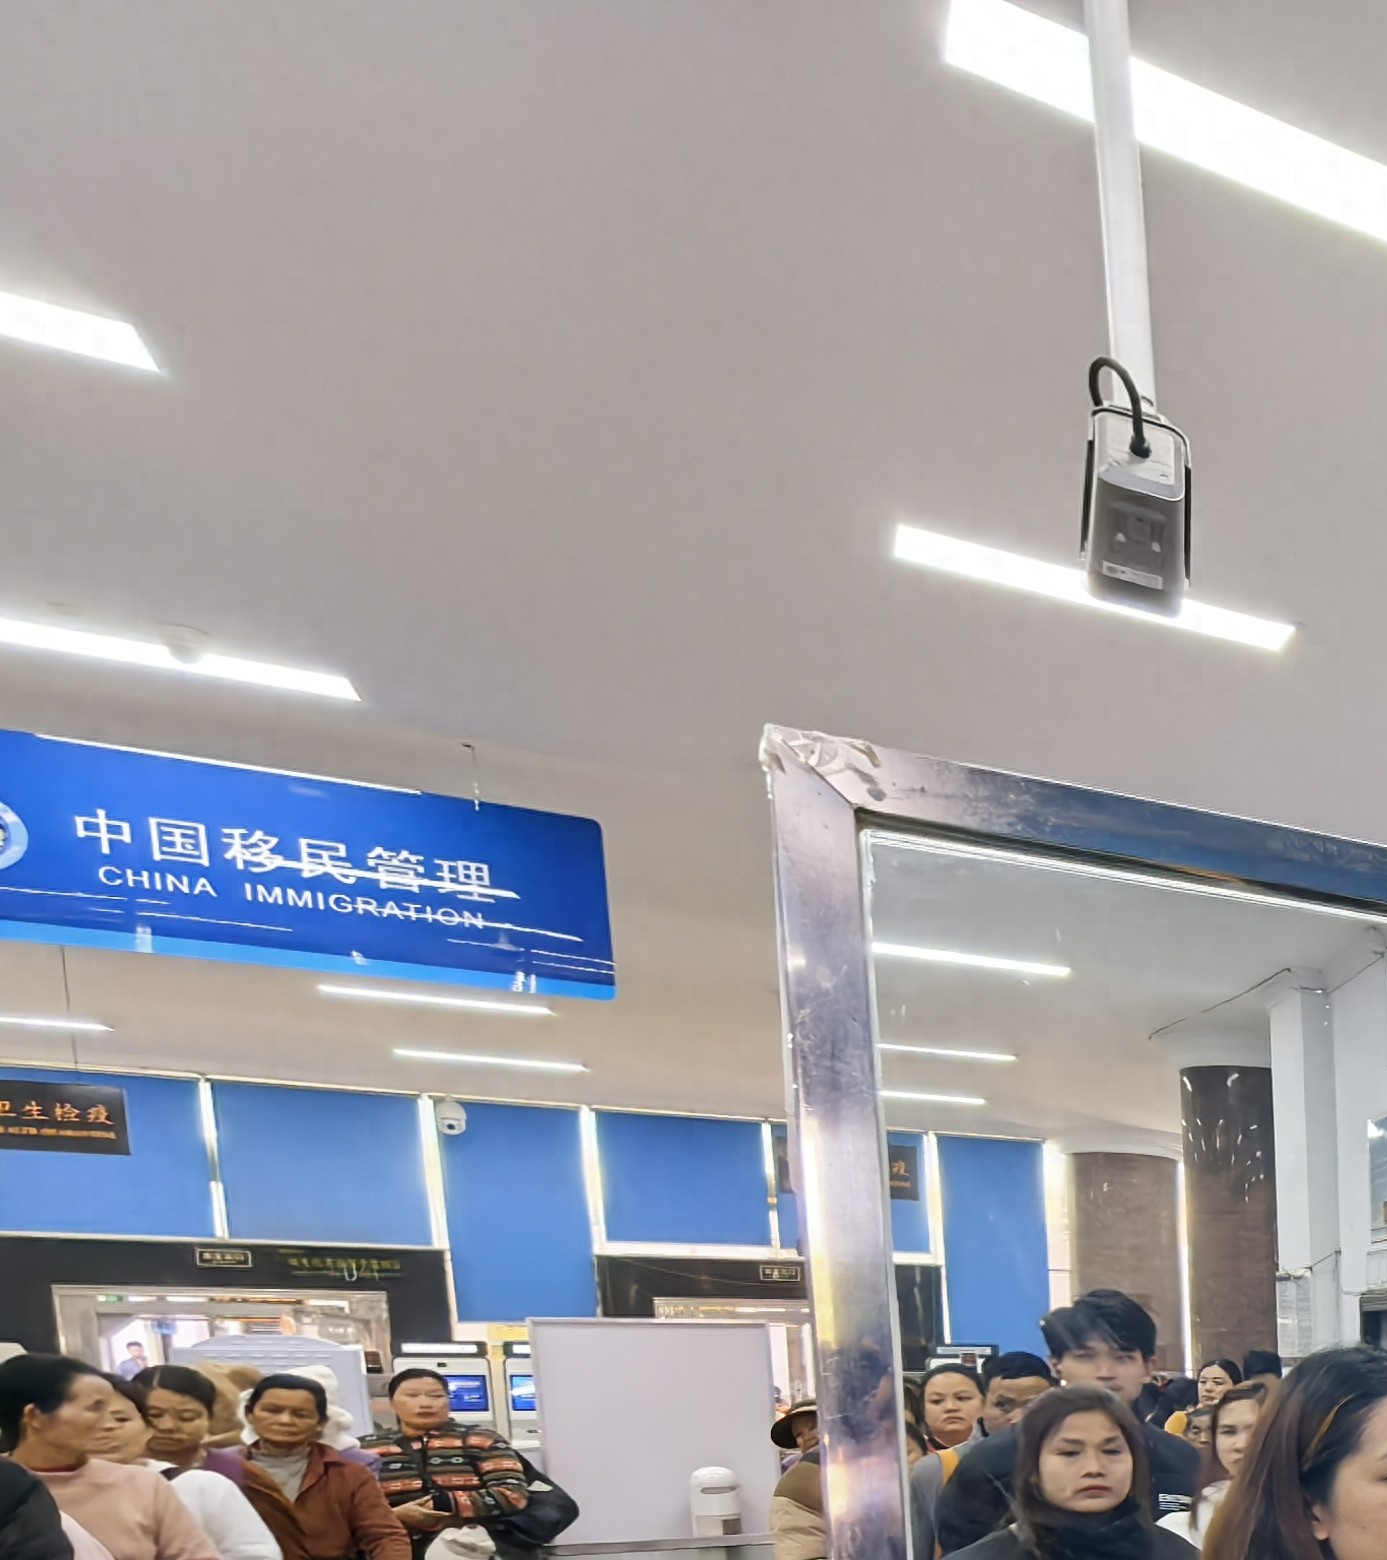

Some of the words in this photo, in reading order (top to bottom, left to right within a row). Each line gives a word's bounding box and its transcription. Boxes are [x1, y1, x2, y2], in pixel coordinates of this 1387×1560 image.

[74, 808, 495, 903] 中国移民管理
[99, 866, 217, 897] CHINA
[244, 882, 484, 930] IMMIGRATION
